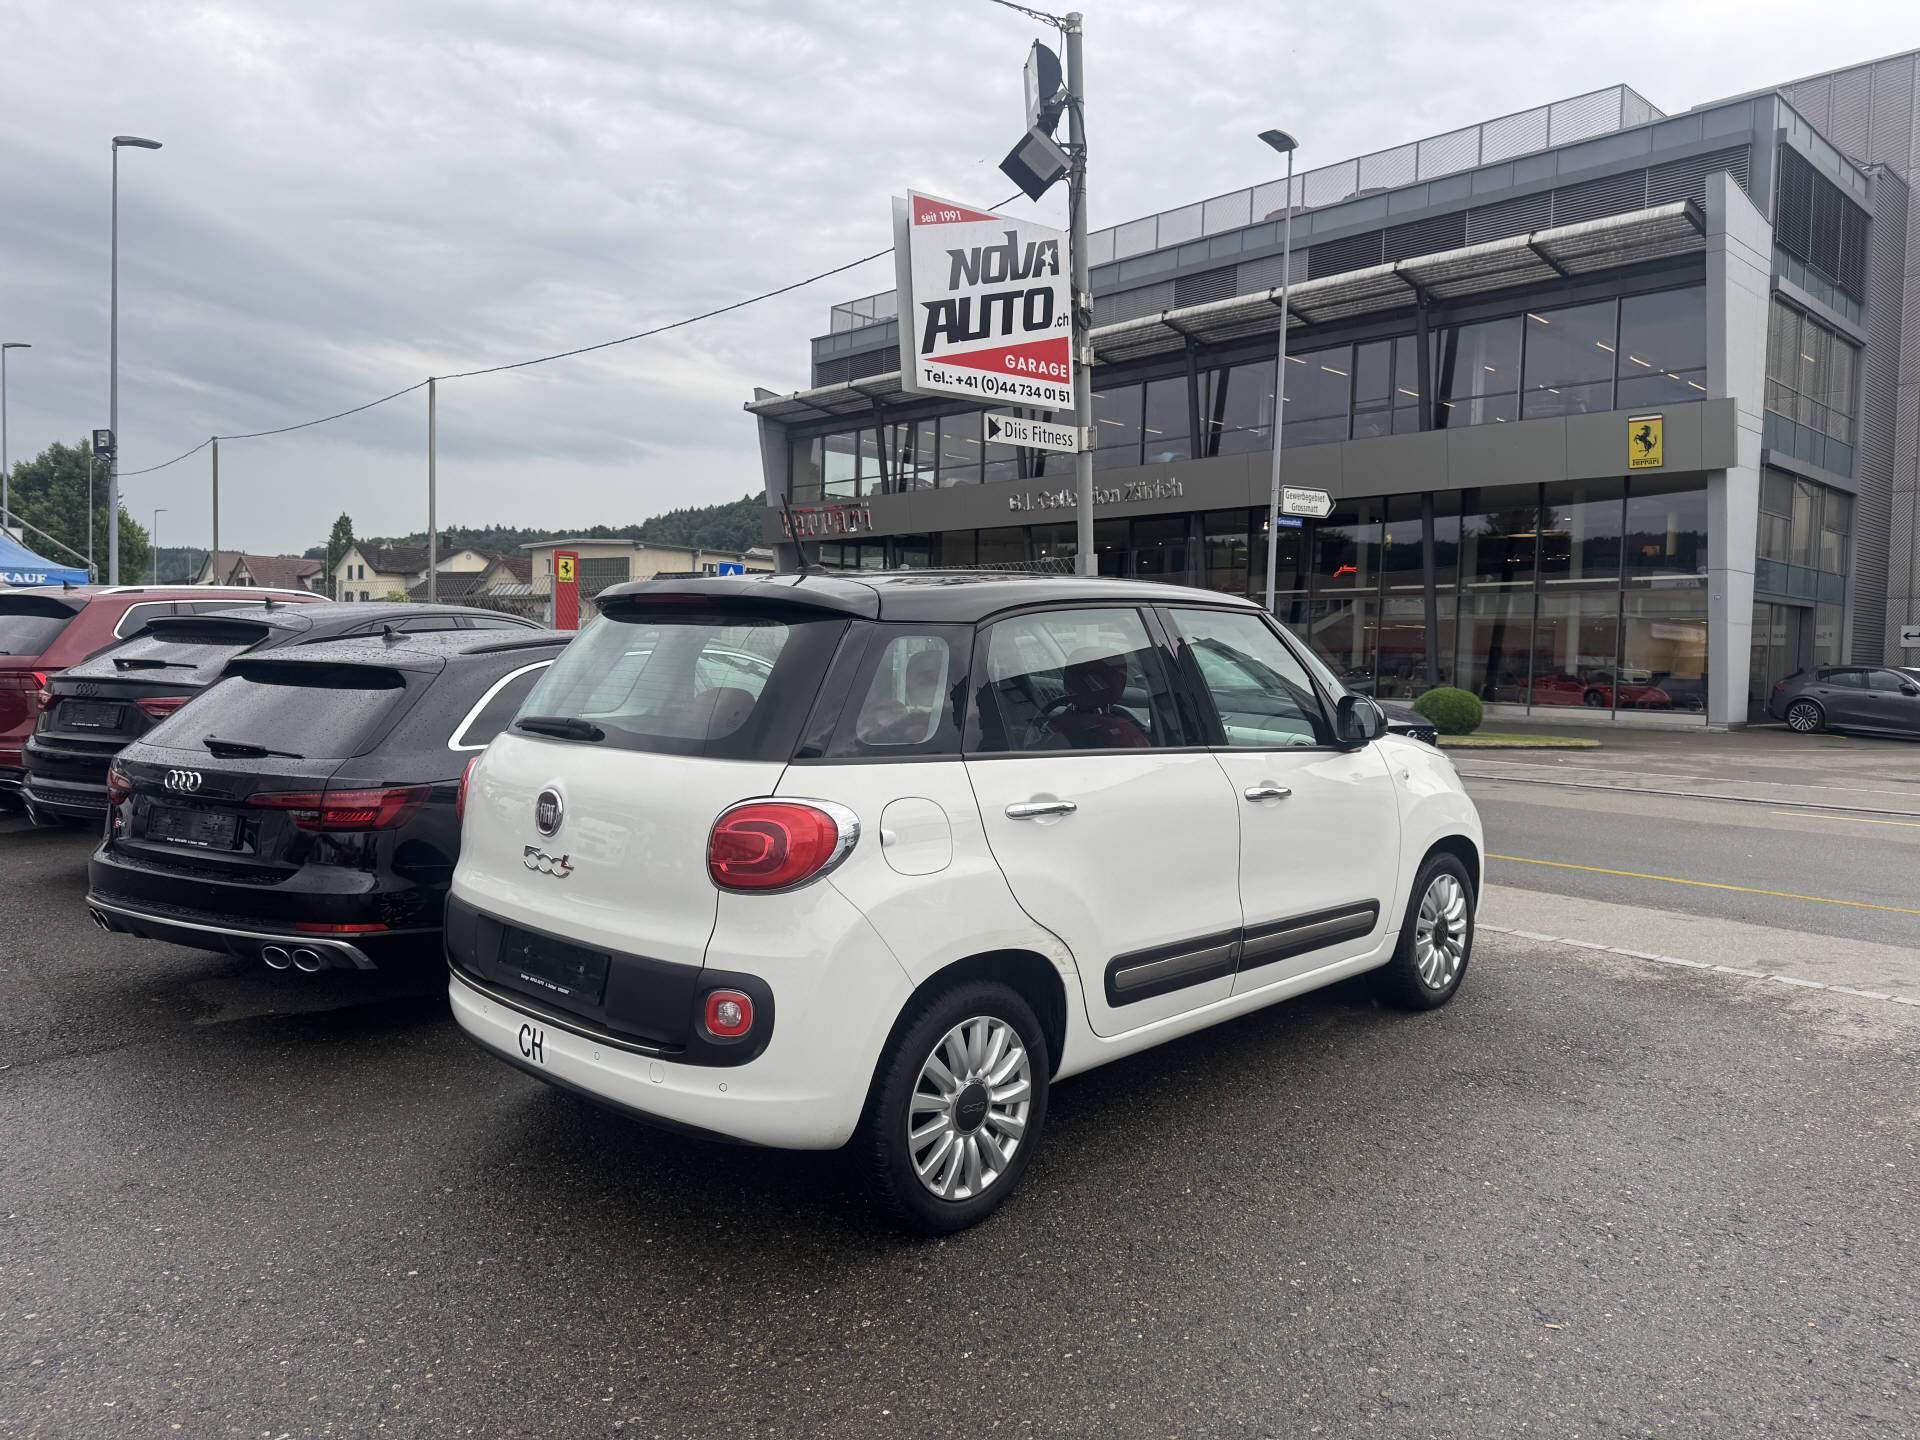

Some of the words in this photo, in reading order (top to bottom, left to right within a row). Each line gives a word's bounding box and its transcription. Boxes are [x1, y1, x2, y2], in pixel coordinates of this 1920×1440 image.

[921, 212, 937, 223] seit
[939, 210, 962, 222] 1991
[945, 230, 1060, 290] NOVA
[1005, 355, 1068, 377] GARAGE
[924, 369, 953, 385] Tel.:
[955, 375, 978, 388] +41
[1019, 384, 1041, 398] 734
[1044, 388, 1056, 401] 01
[1059, 390, 1070, 403] 51
[1005, 421, 1028, 440] Diis
[1032, 426, 1073, 447] Fitness
[1124, 477, 1183, 501] Zürich
[1285, 490, 1325, 504] Gewerbegebiet
[540, 803, 556, 825] FIAT
[519, 1023, 544, 1064] CH
